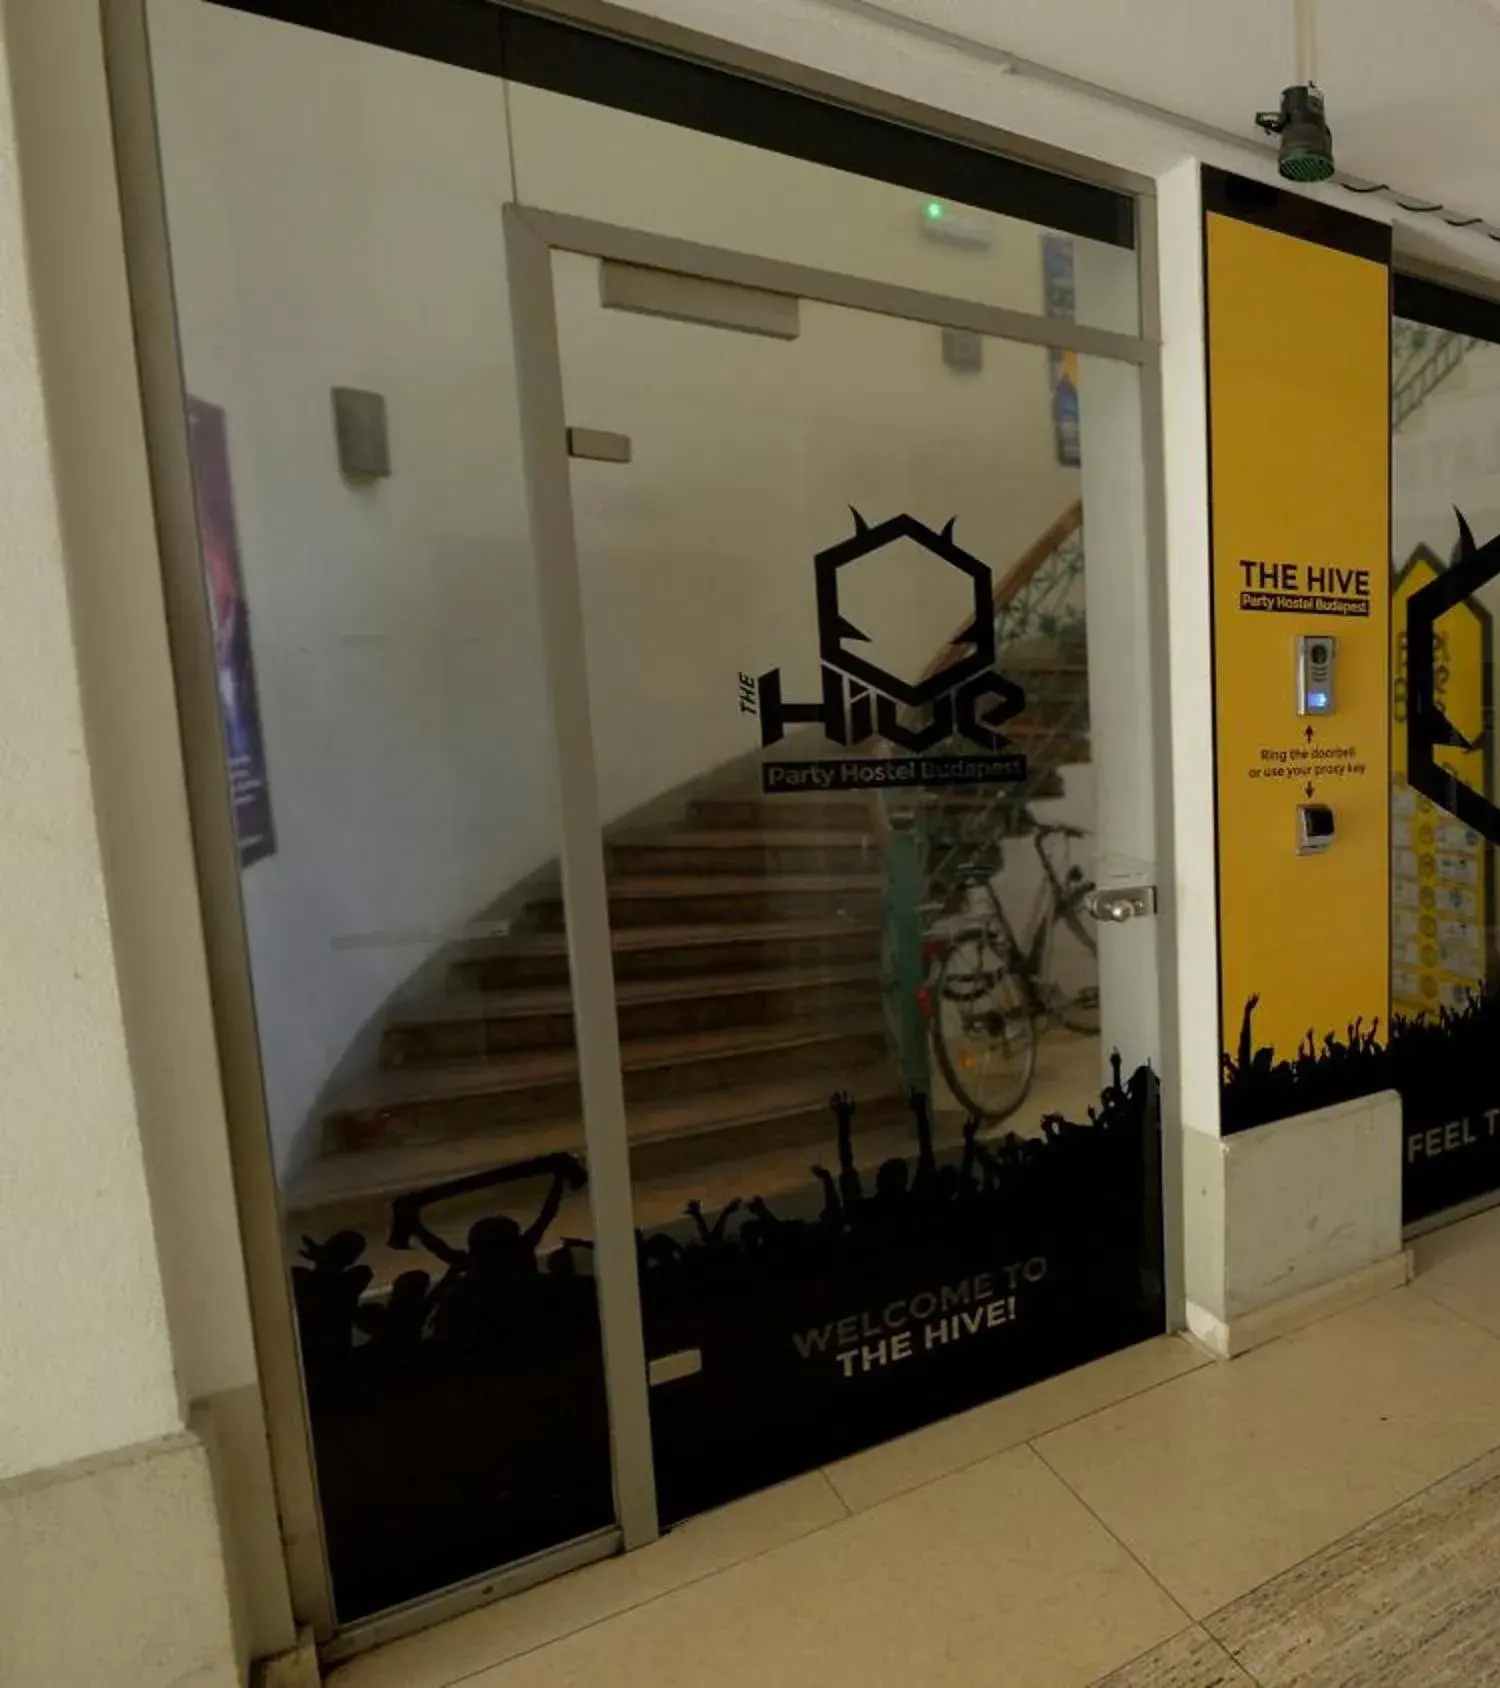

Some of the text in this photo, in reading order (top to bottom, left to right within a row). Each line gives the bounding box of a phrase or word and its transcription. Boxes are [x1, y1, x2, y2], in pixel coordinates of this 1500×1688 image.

[1239, 560, 1370, 595] THE HIVE
[1243, 594, 1367, 614] Party Hostel Budapest
[739, 671, 757, 716] THE
[1260, 747, 1356, 762] Ring the doorbell
[768, 759, 1022, 788] Party Hostel Budapest
[1248, 769, 1261, 778] or
[1264, 768, 1285, 778] use
[1287, 766, 1313, 779] your
[1408, 1117, 1477, 1164] FEEL
[792, 1256, 1048, 1359] WELCOME TO
[836, 1296, 1016, 1377] THE HIVE!
